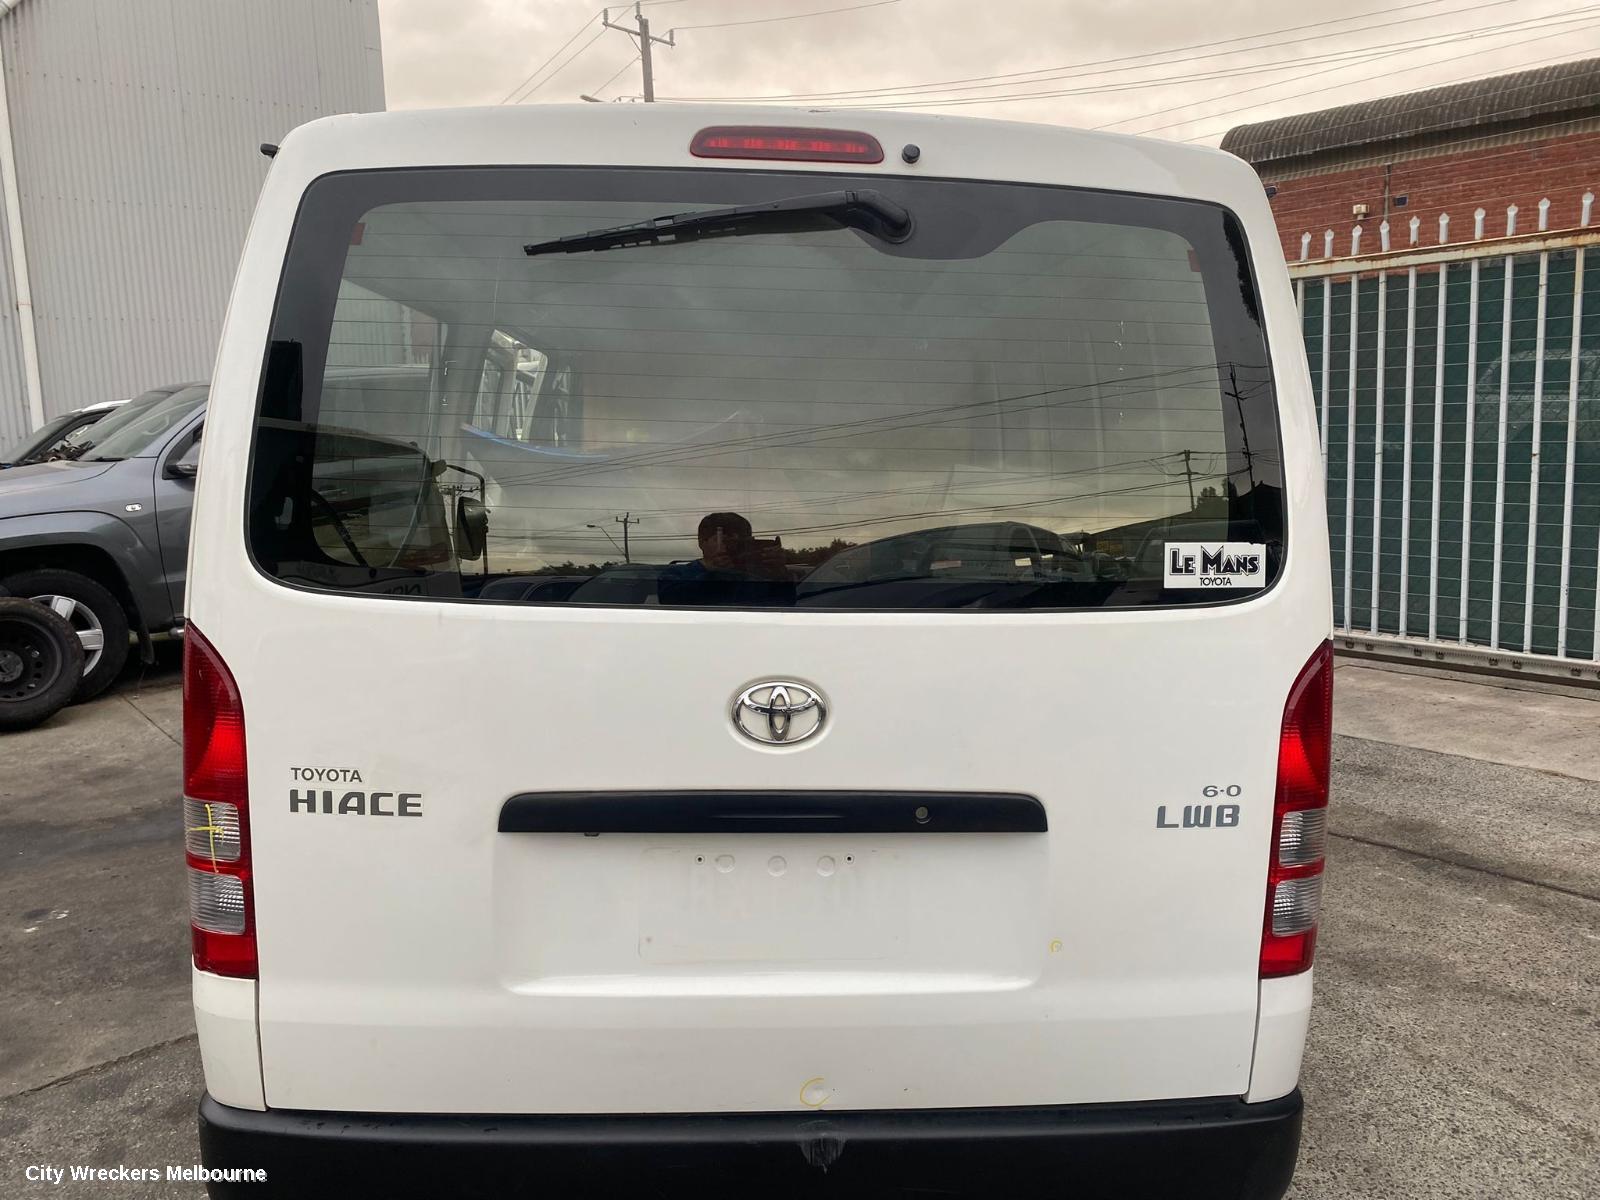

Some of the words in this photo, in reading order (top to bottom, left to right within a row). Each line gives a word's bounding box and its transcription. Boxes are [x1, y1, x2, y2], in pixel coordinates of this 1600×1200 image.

[1200, 577, 1233, 587] TOYOTA
[290, 767, 363, 783] TOYOTA
[289, 789, 423, 817] HIACE
[1156, 804, 1240, 828] LWB
